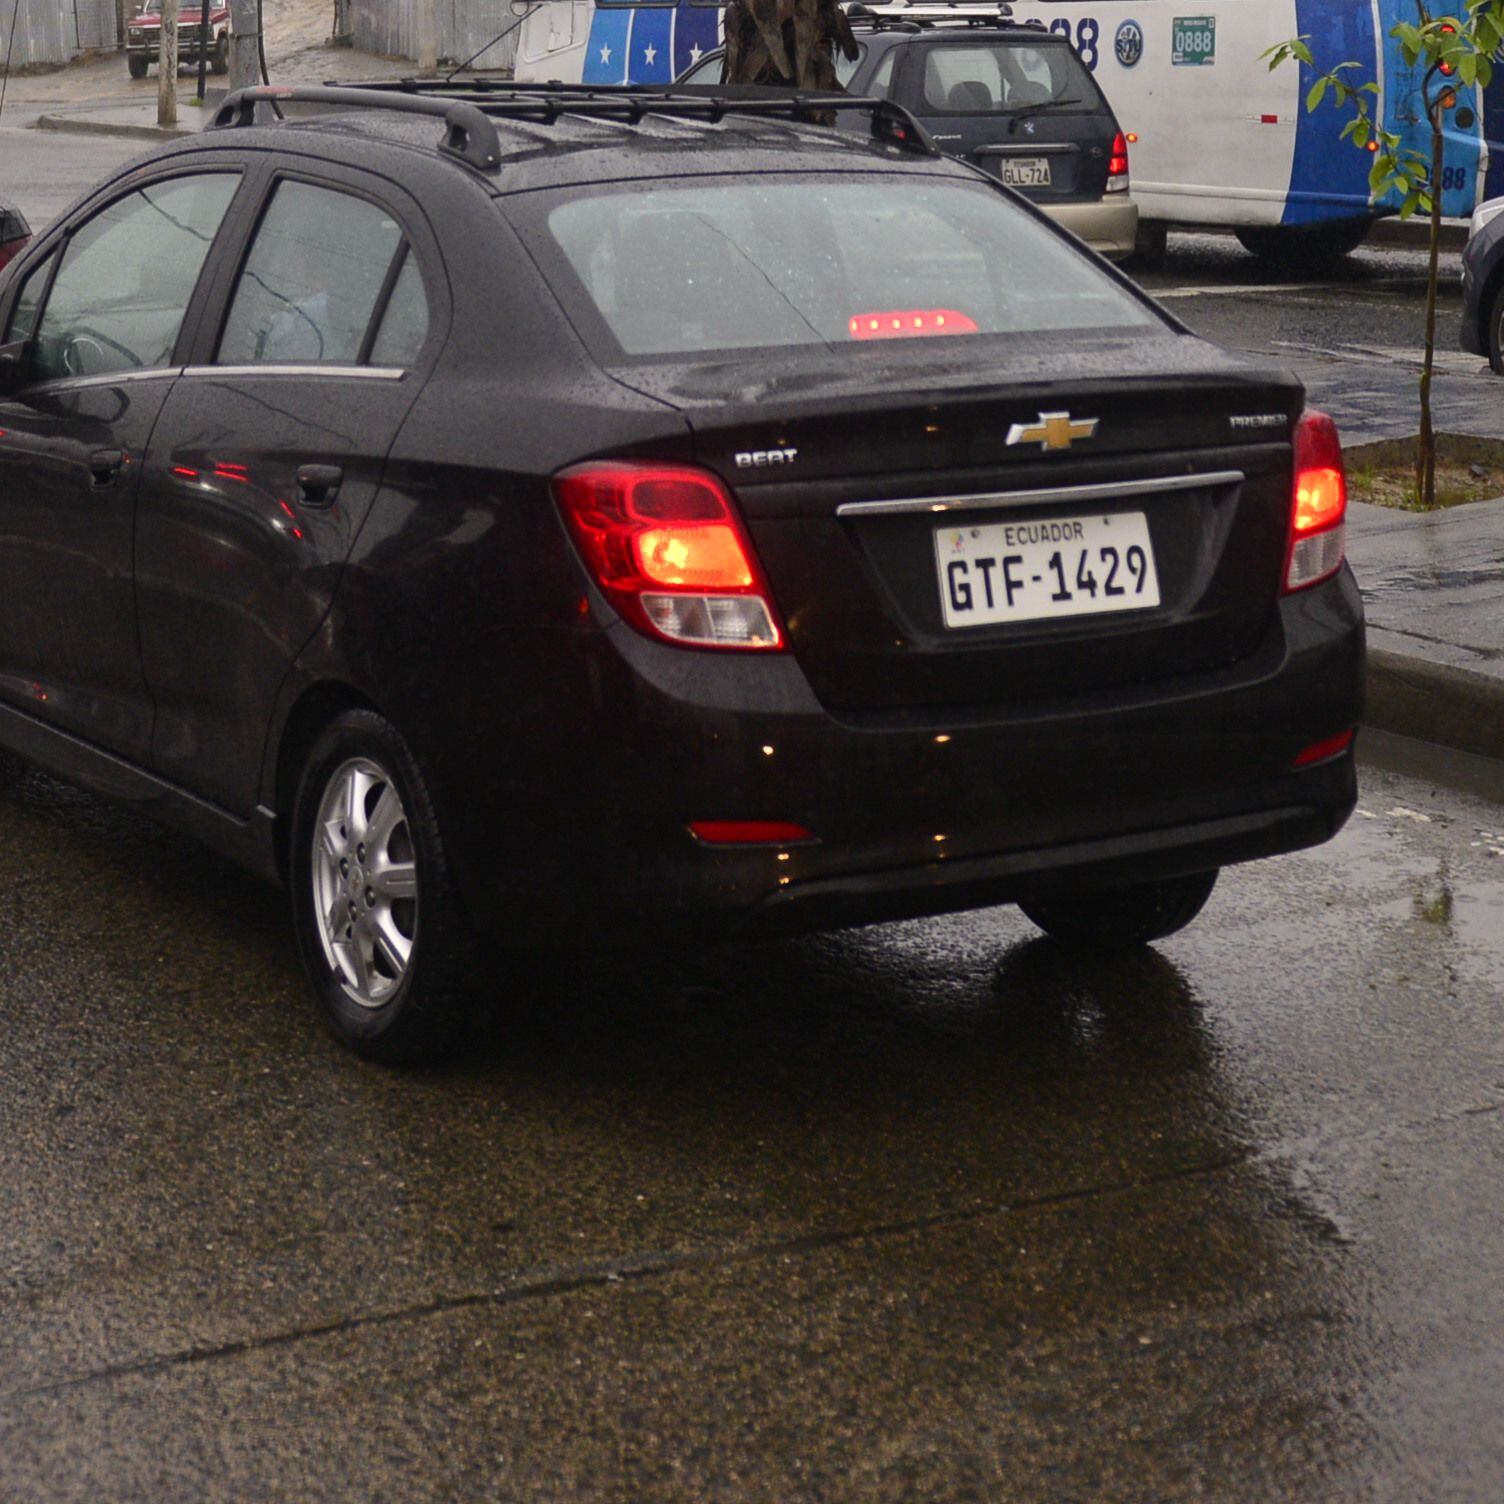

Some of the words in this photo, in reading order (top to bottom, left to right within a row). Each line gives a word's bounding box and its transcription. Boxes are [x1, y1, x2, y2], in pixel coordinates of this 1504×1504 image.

[1176, 31, 1212, 52] 0888
[734, 448, 798, 468] BEAT
[1004, 521, 1085, 546] ECUADOR
[947, 544, 1147, 611] GTF-1429
